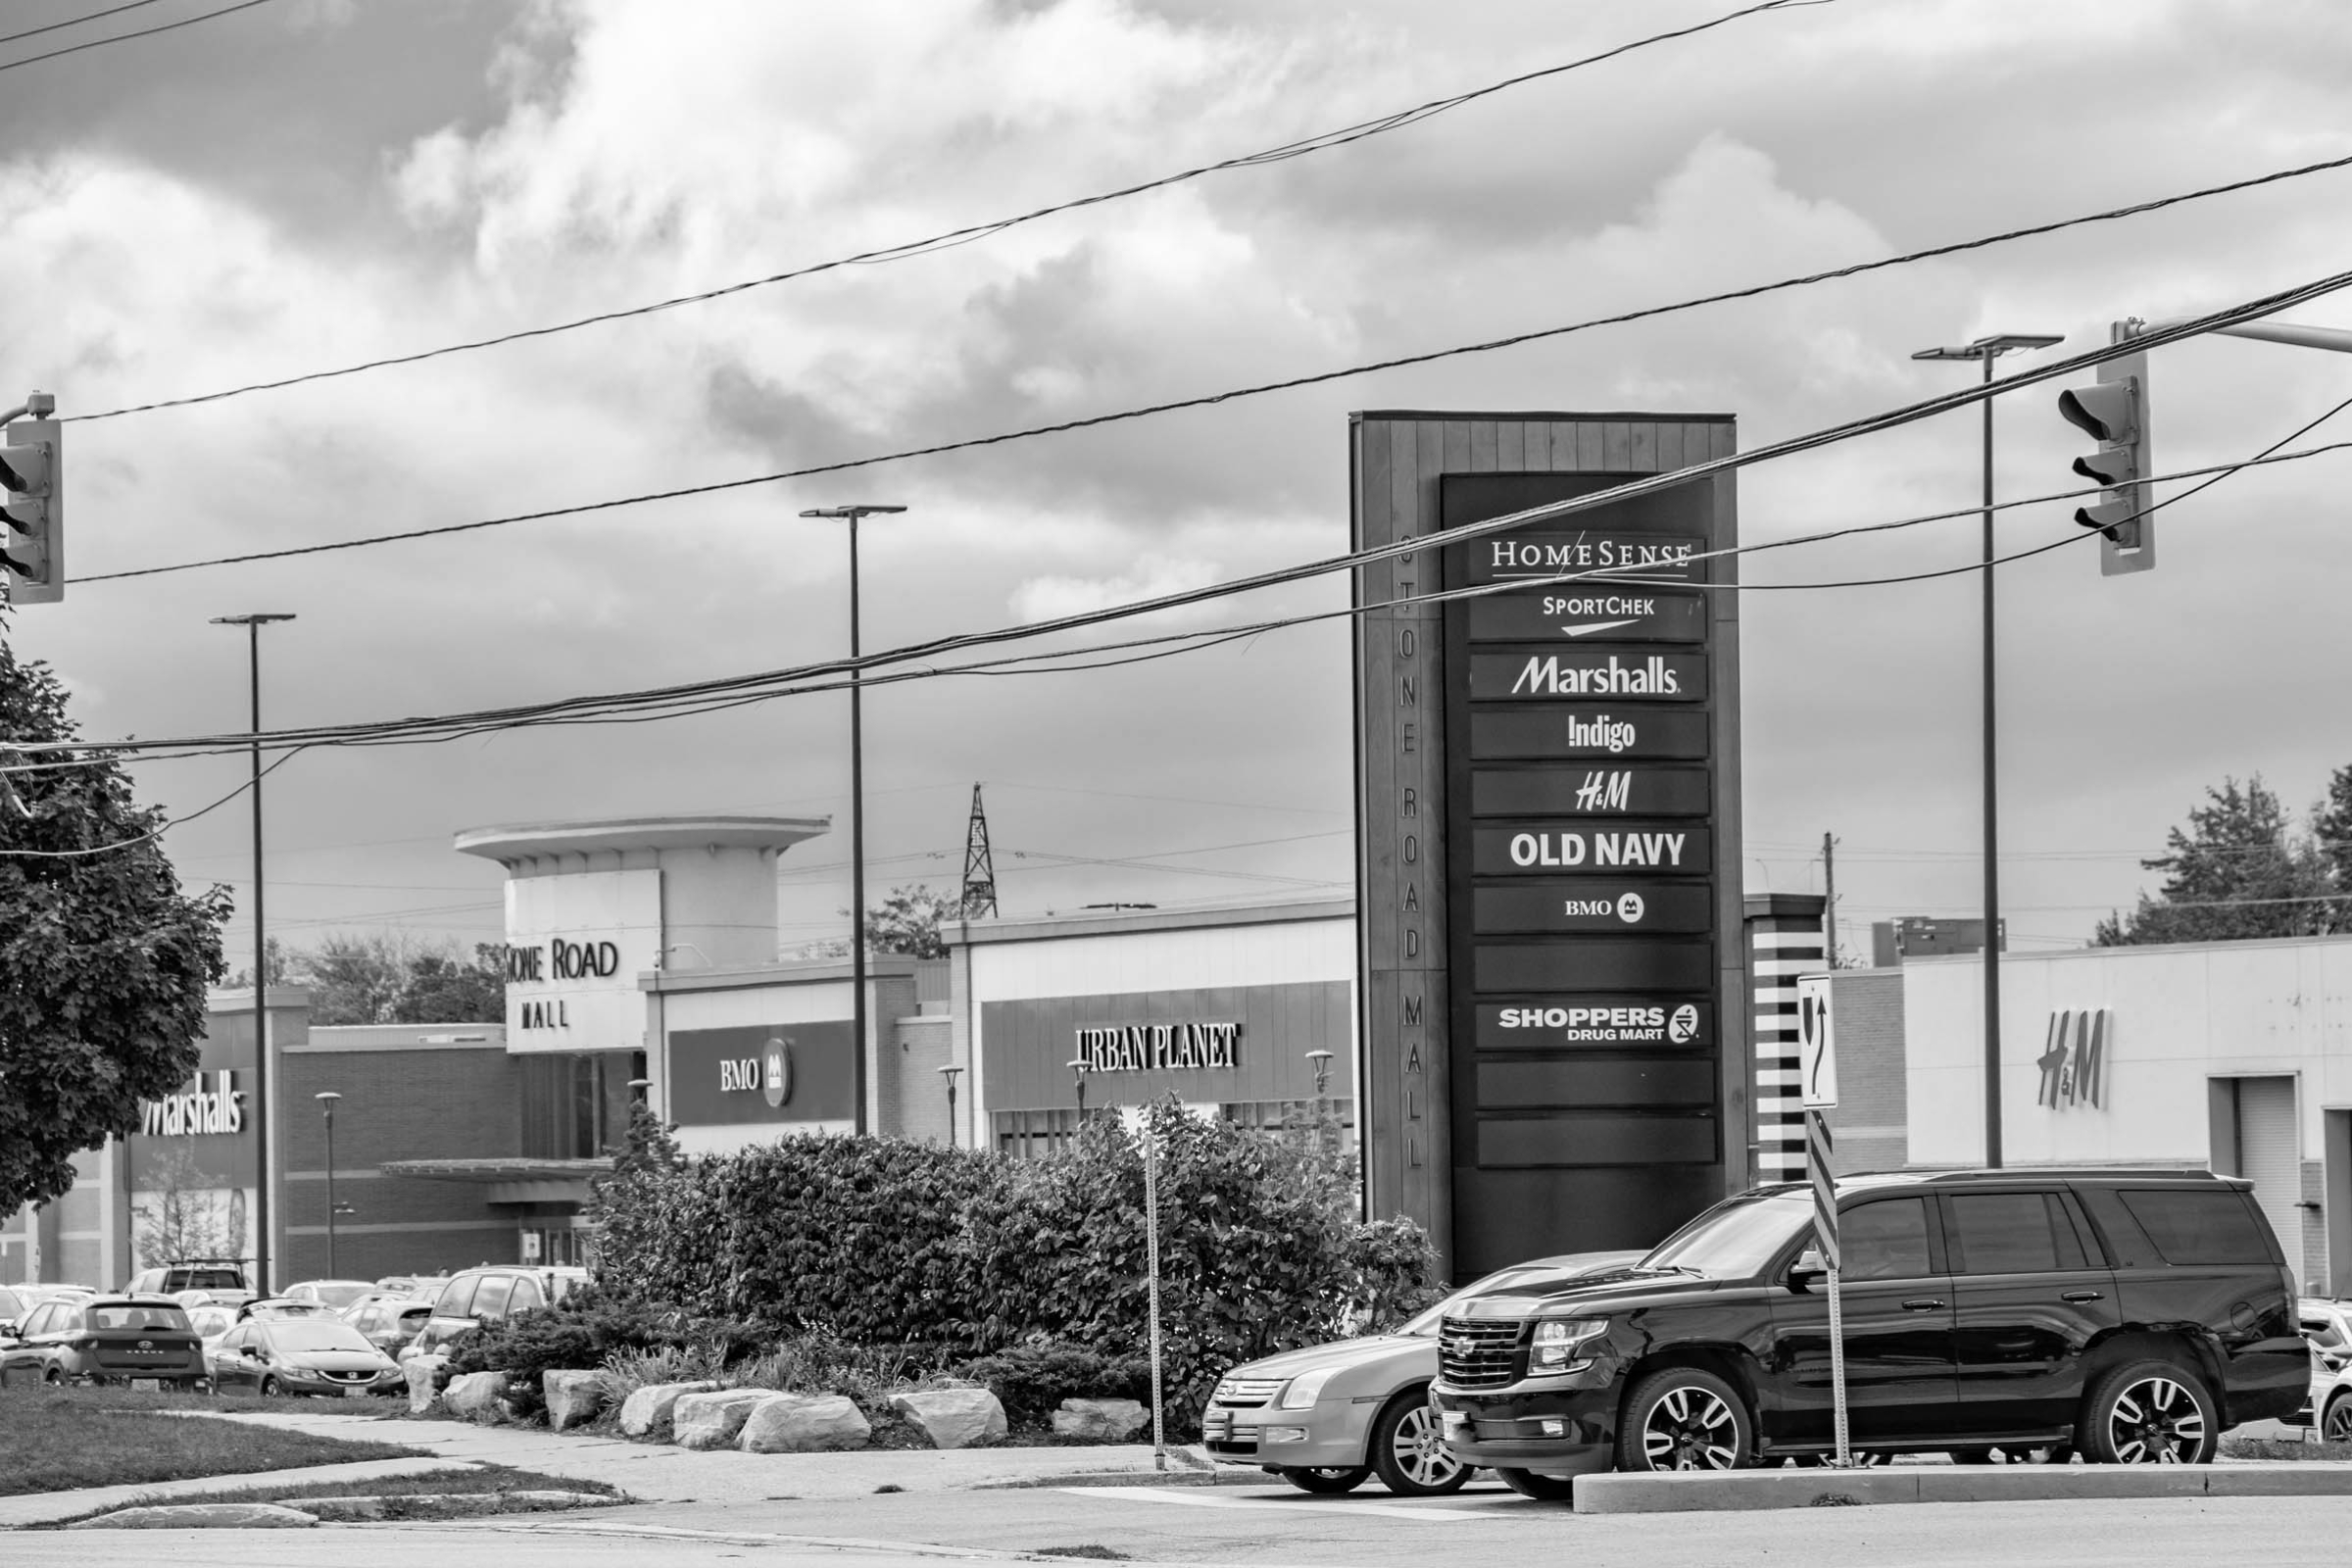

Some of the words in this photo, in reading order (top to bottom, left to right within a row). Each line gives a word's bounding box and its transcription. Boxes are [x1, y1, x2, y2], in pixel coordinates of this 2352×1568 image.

[1544, 596, 1654, 614] SPORTCHEK
[1512, 656, 1677, 694] Marshalls
[1568, 714, 1636, 753] Indigo
[1576, 770, 1632, 811] H&M
[1510, 833, 1586, 866] OLD
[1594, 833, 1686, 866] NAVY
[1401, 788, 1418, 960] ROAD
[1565, 901, 1612, 915] BMO
[552, 938, 618, 979] ROAD
[521, 1000, 569, 1029] MALL
[1498, 1007, 1665, 1028] SHOPPERS
[1075, 1026, 1149, 1073] URBAN
[1152, 1023, 1238, 1069] PLANET
[1568, 1029, 1616, 1041] DRUG
[1619, 1029, 1664, 1041] MART
[719, 1058, 760, 1091] BMO
[2037, 1008, 2105, 1110] H&M
[1402, 995, 1422, 1169] MALL
